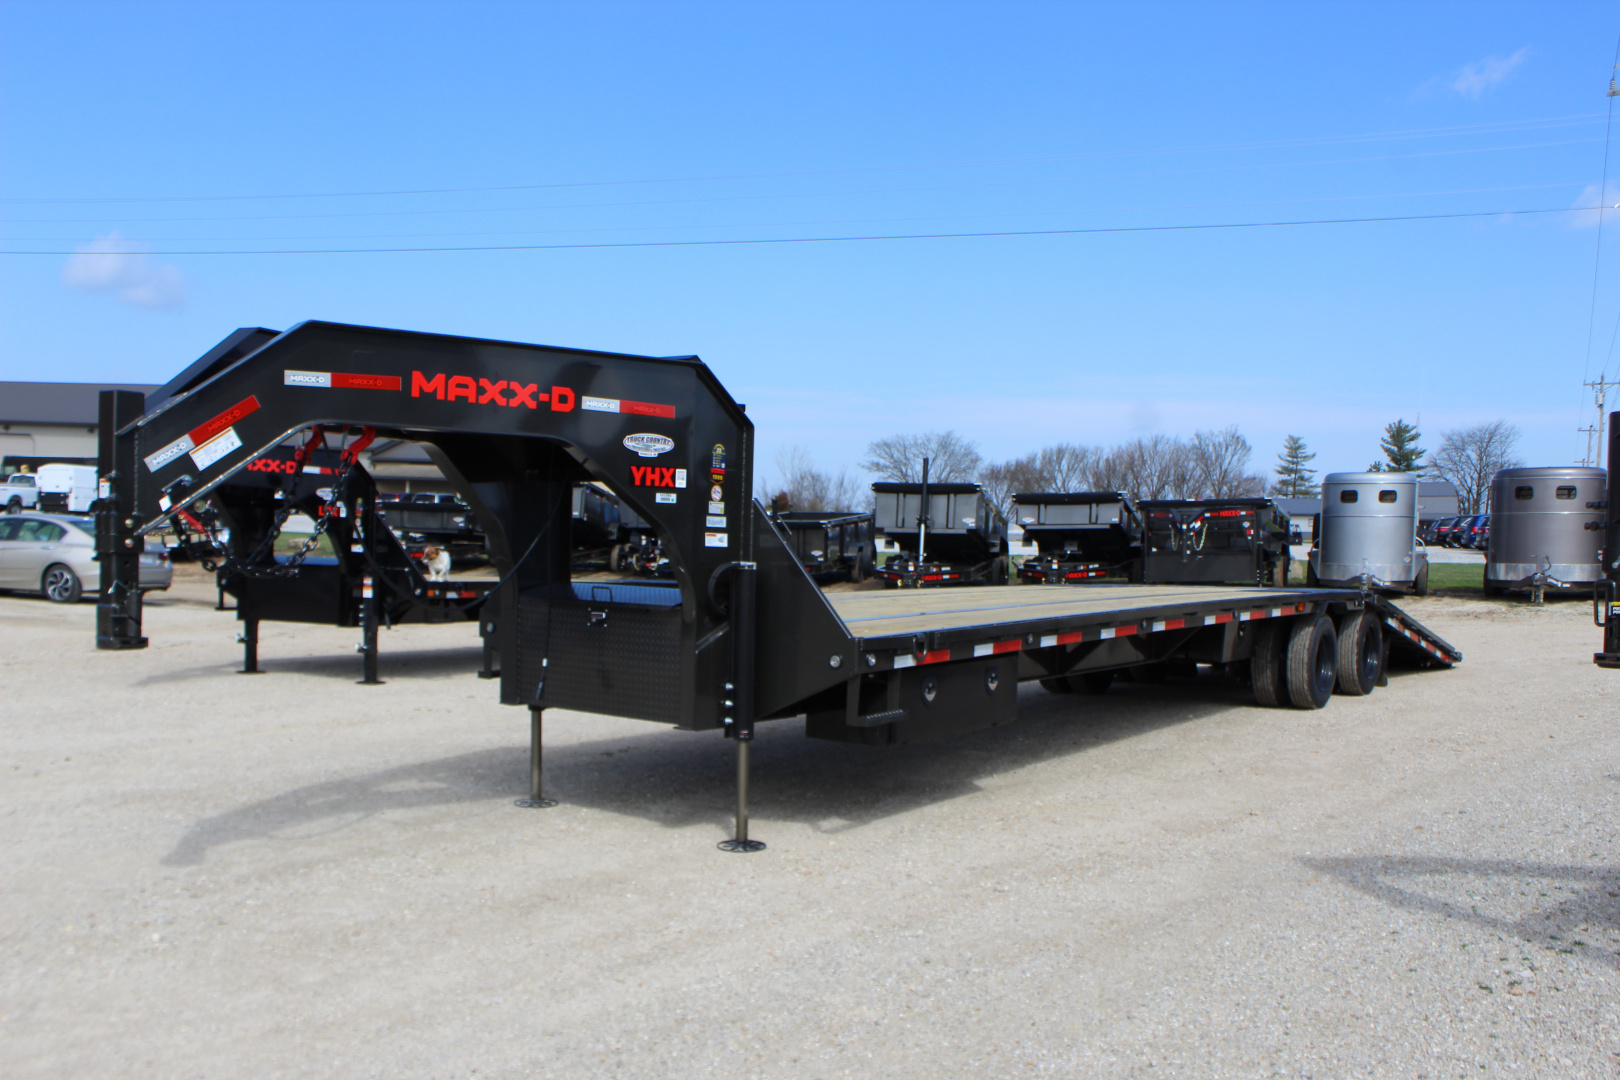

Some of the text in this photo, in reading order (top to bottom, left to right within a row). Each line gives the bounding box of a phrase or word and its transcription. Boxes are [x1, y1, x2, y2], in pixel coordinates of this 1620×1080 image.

[290, 375, 325, 384] MAXX-D
[349, 378, 383, 387] MAXX-D
[411, 370, 575, 413] MAXX-D
[586, 401, 615, 409] MAXX-D
[634, 405, 661, 414] MAXX-D
[207, 409, 240, 432] MAXX-D
[152, 442, 187, 465] MAXX-D
[246, 458, 297, 475] XX-D
[631, 466, 675, 487] YHX
